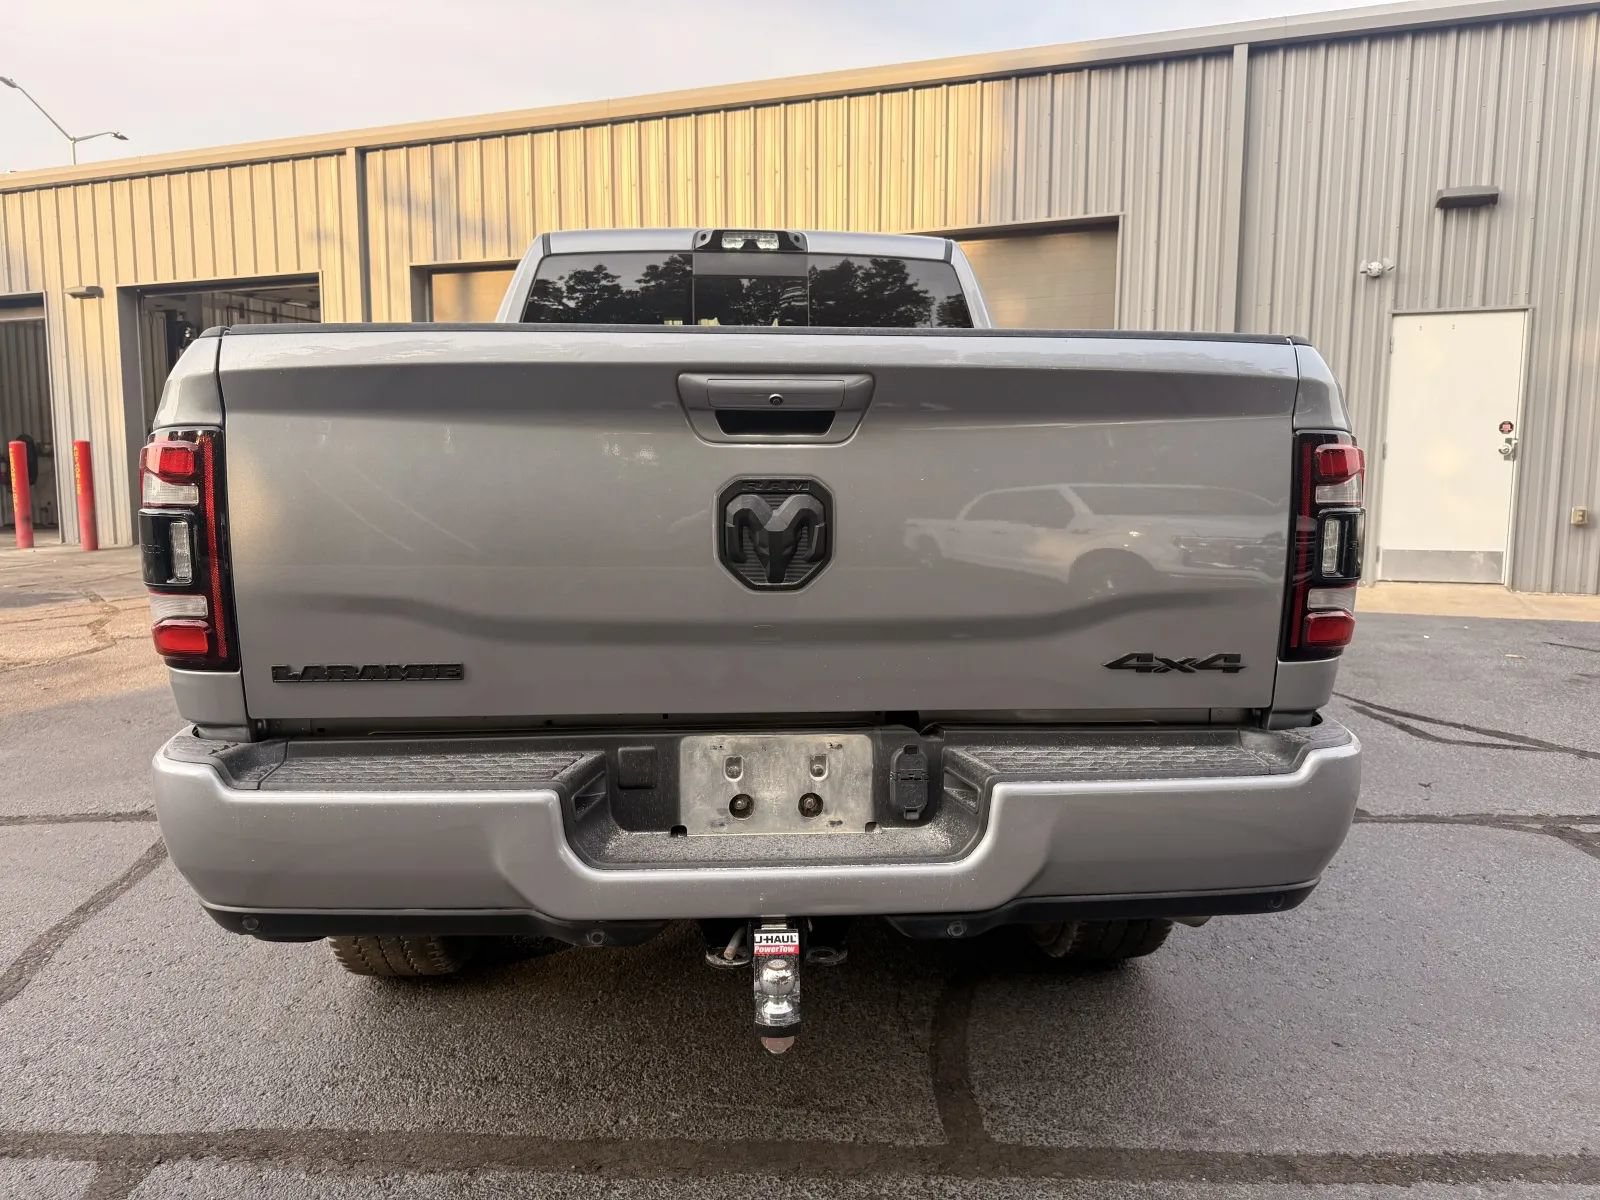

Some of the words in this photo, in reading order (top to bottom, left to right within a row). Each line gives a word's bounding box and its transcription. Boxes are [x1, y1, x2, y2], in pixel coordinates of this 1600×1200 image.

[741, 480, 809, 491] RAM
[271, 664, 464, 682] LARAMIE
[754, 945, 795, 953] PowerTow
